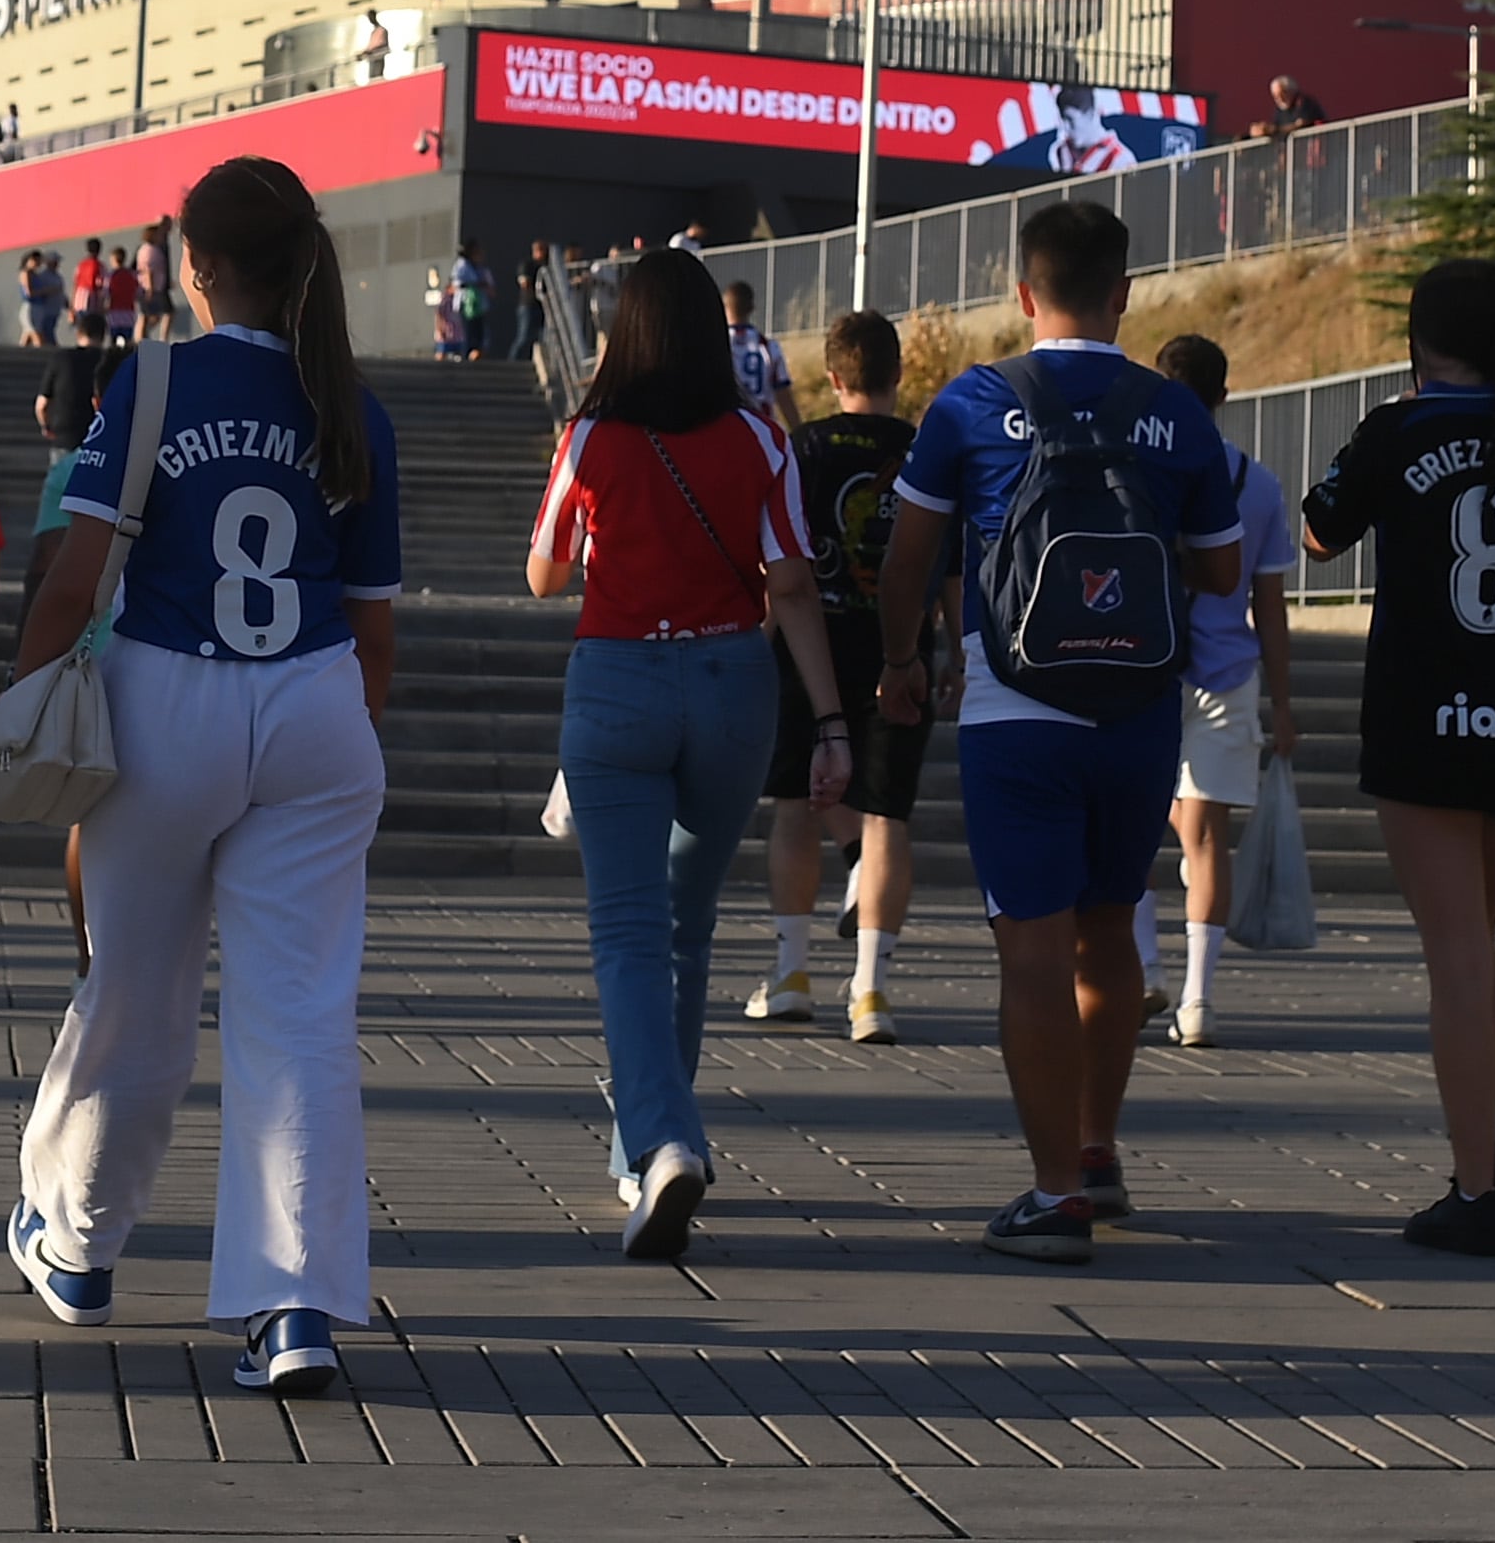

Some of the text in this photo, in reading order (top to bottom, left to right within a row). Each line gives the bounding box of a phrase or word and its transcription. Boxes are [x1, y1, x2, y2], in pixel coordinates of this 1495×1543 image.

[505, 44, 654, 80] HAZTE SOCIO
[506, 67, 956, 136] VIVE LA PASIÓN DESDE DNTRO
[213, 486, 301, 656] 8
